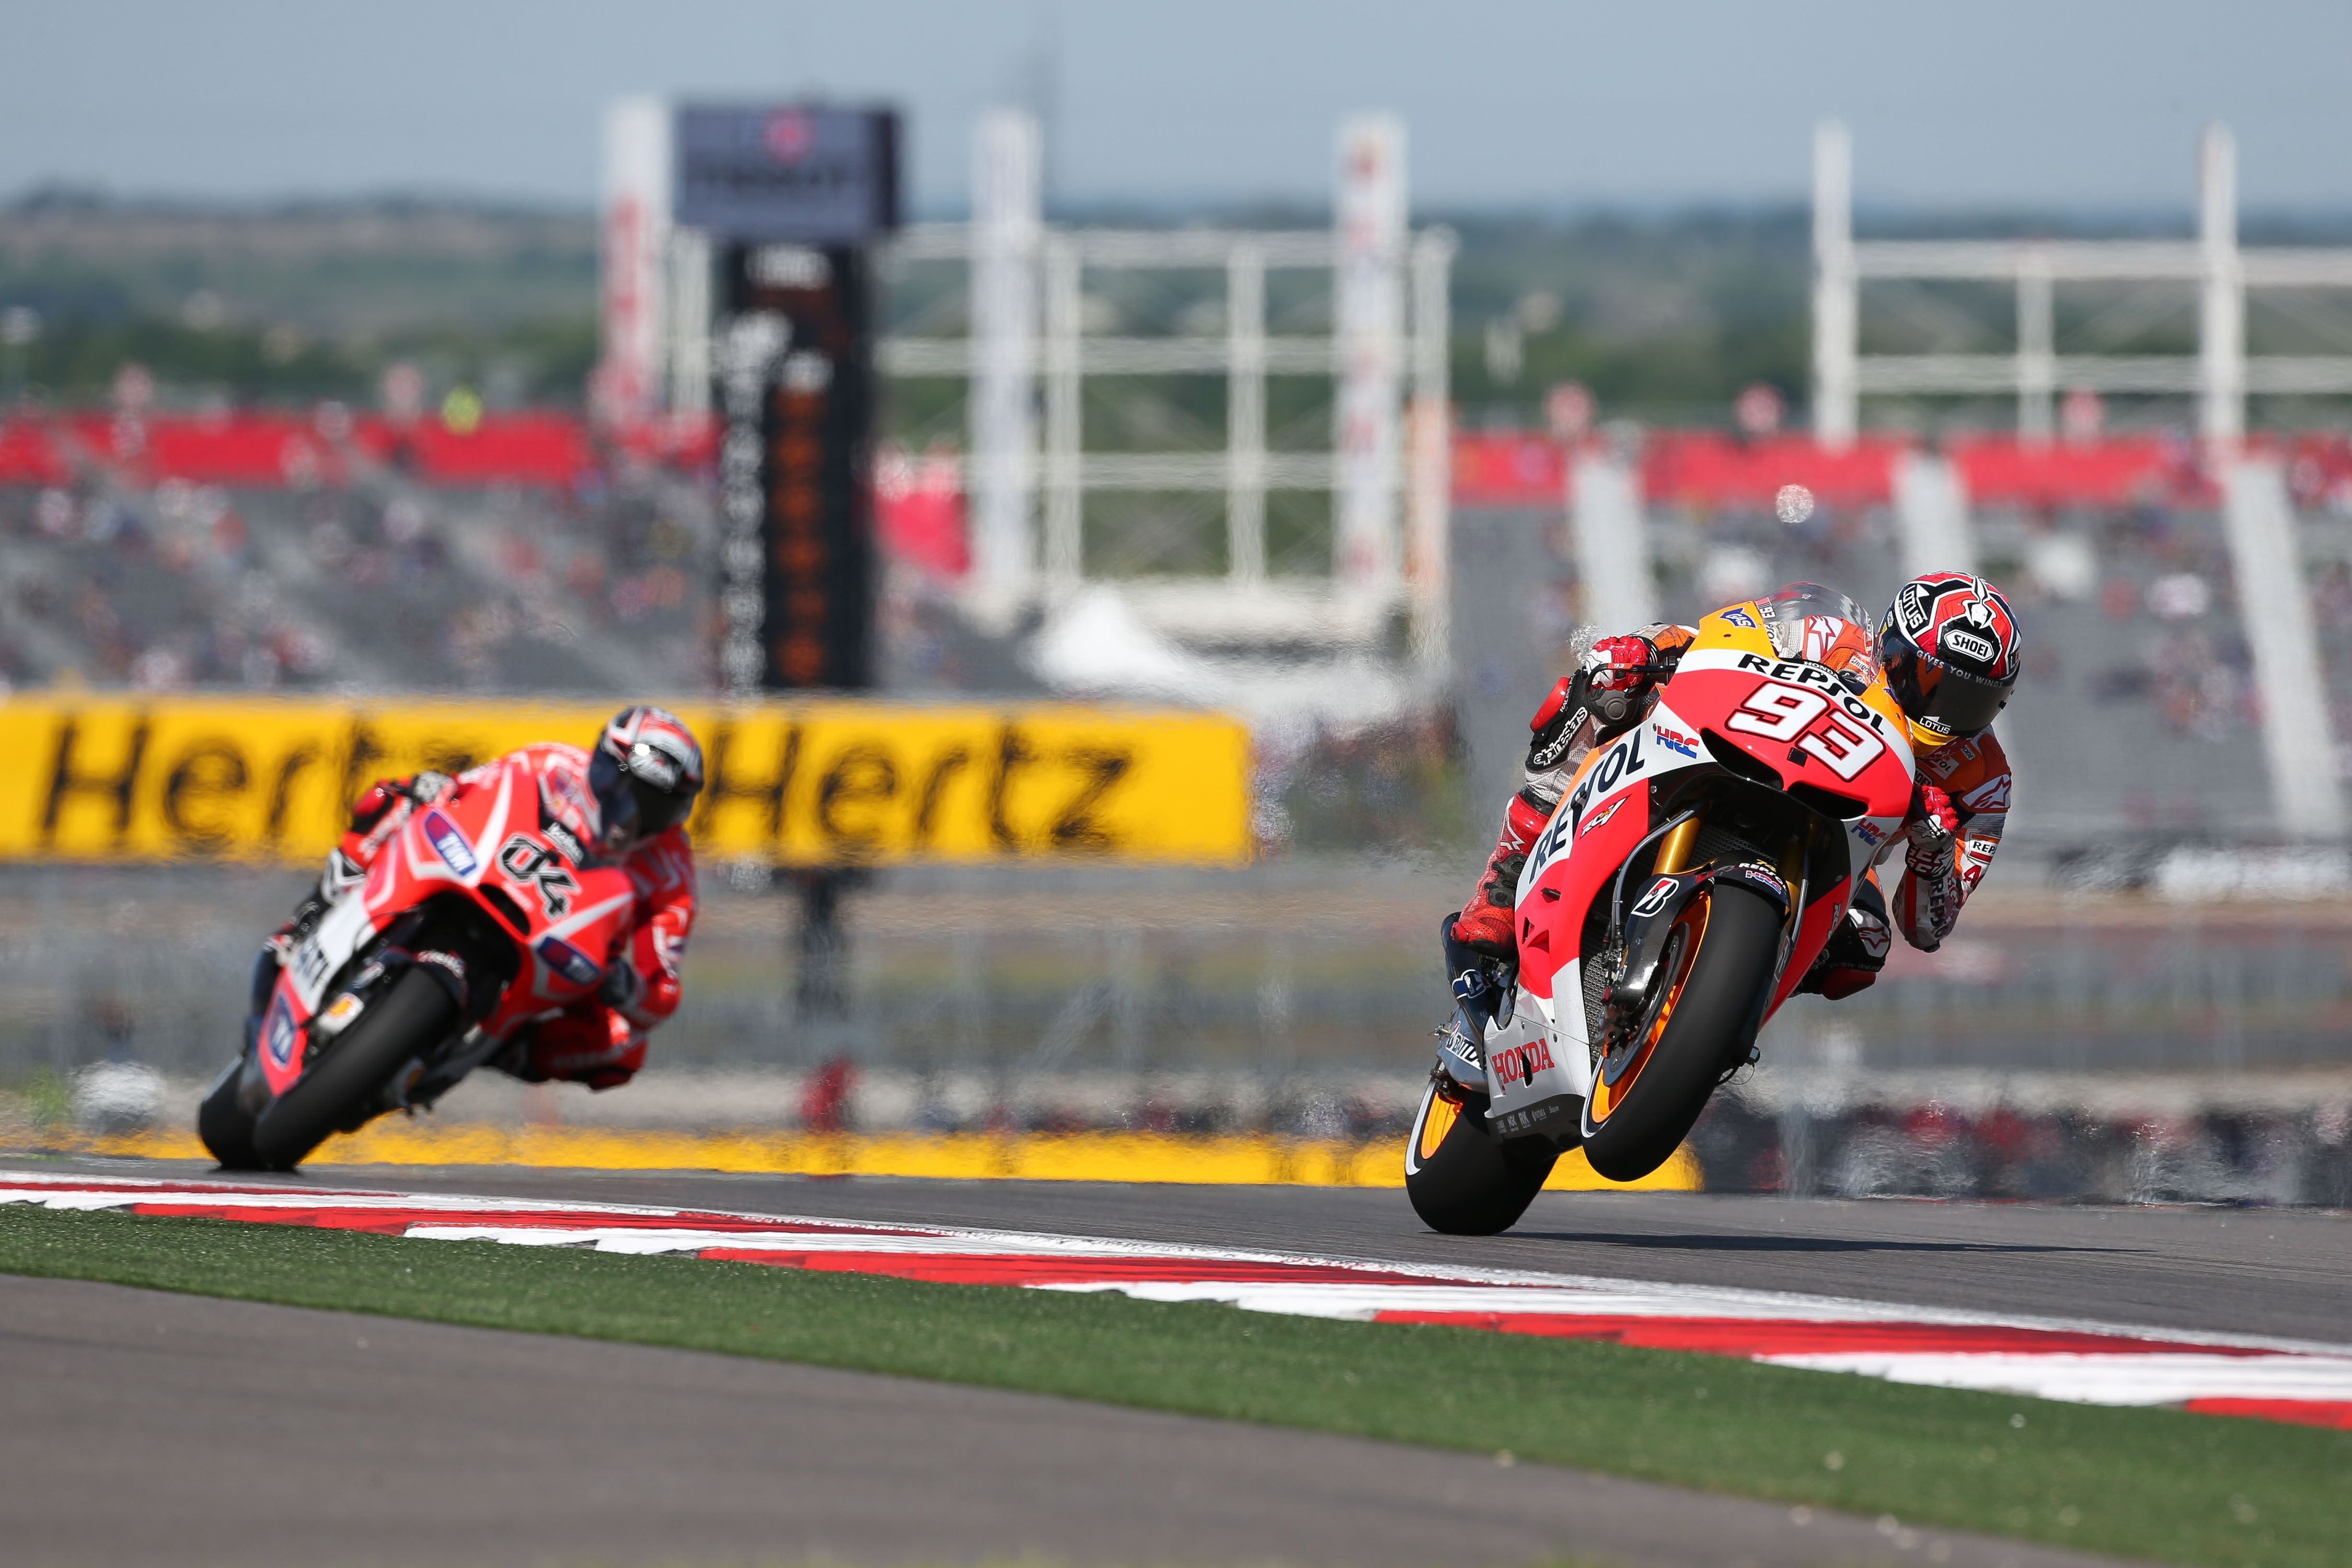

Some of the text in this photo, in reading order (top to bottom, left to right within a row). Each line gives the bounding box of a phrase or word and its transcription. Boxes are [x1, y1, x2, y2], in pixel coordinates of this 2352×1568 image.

[1759, 605, 1776, 618] 93
[1903, 584, 1923, 629] LOTUS
[1952, 634, 1988, 658] SHOEI
[1803, 661, 1839, 679] HONDA
[1916, 650, 2003, 688] GIVES YOU WINGS
[1738, 654, 1885, 735] REPSOL
[1656, 725, 1700, 759] HRC
[1725, 681, 1886, 782] 93
[1919, 717, 1951, 734] LOTUS
[40, 712, 477, 843] Hert
[689, 713, 1136, 847] Hertz
[1739, 863, 1787, 892] REPSOL
[1745, 870, 1782, 895] HRC
[1491, 1037, 1555, 1087] HONDA
